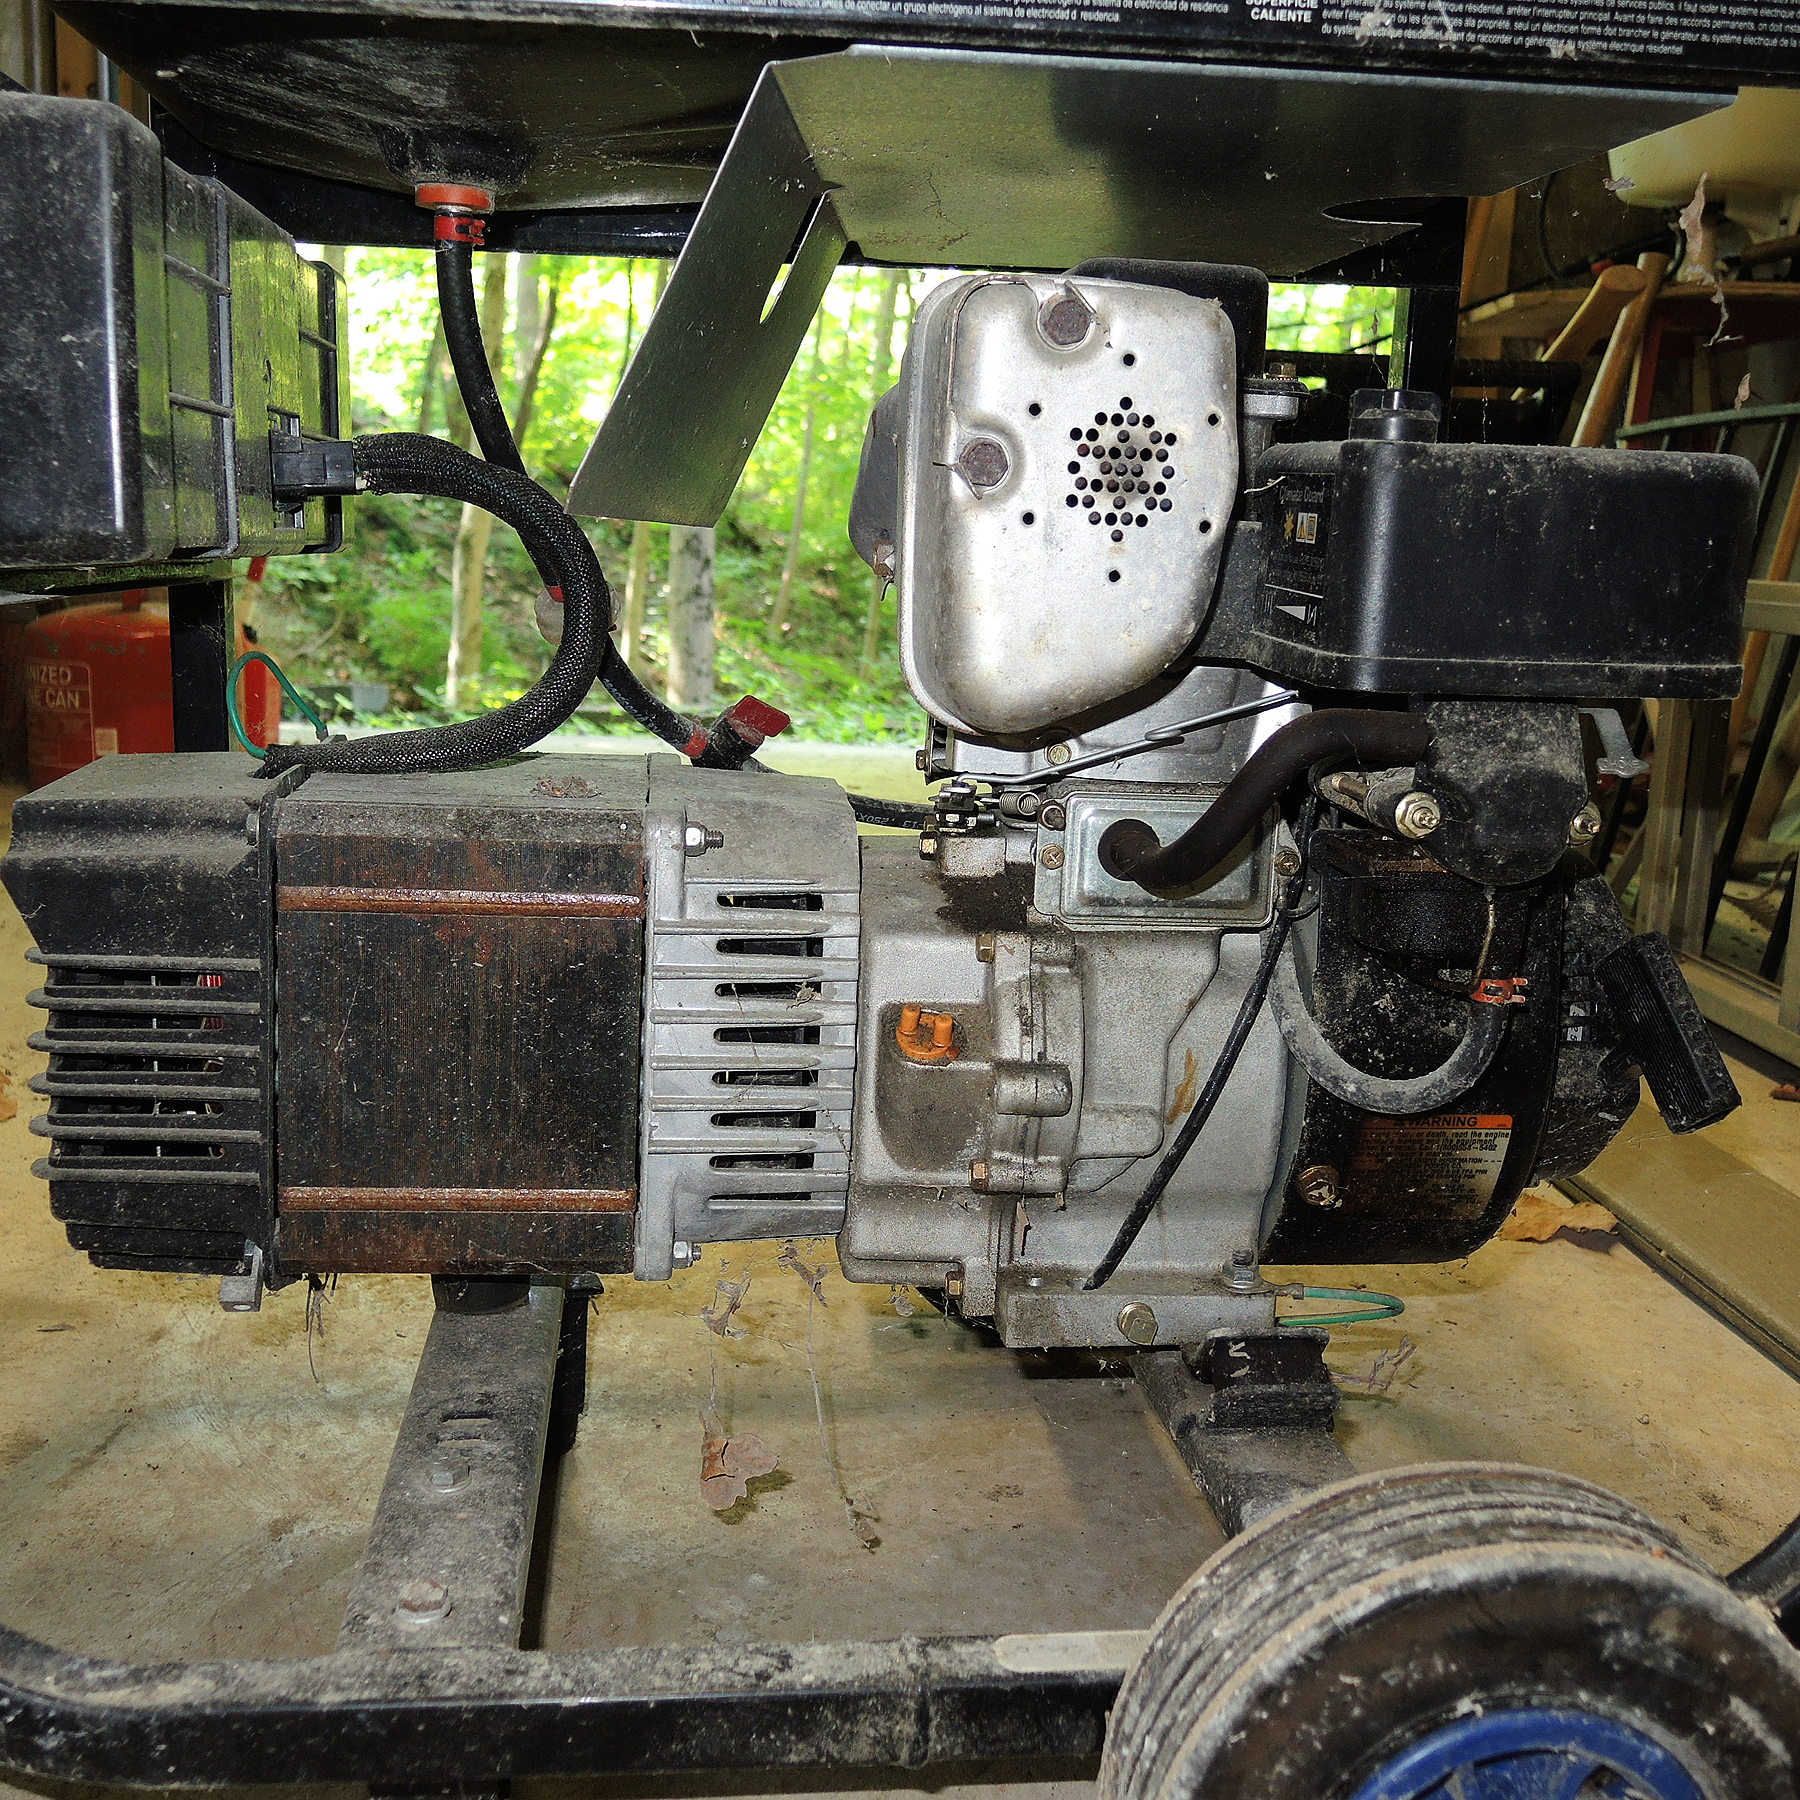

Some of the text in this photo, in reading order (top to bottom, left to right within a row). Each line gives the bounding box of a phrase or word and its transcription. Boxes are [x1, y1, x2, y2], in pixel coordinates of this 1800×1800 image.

[857, 1, 891, 12] conectar
[903, 3, 927, 15] grupo
[974, 4, 982, 16] al
[983, 5, 1014, 17] sistema
[1014, 7, 1026, 19] de
[1190, 2, 1229, 13] residencia
[1250, 8, 1312, 23] CALIENTE
[1613, 11, 1634, 23] Avant
[1636, 13, 1646, 24] de
[1665, 15, 1679, 26] des
[45, 687, 80, 709] CAN
[1409, 1115, 1478, 1128] WARNING
[1470, 1130, 1482, 1138] the
[1484, 1130, 1510, 1140] engine
